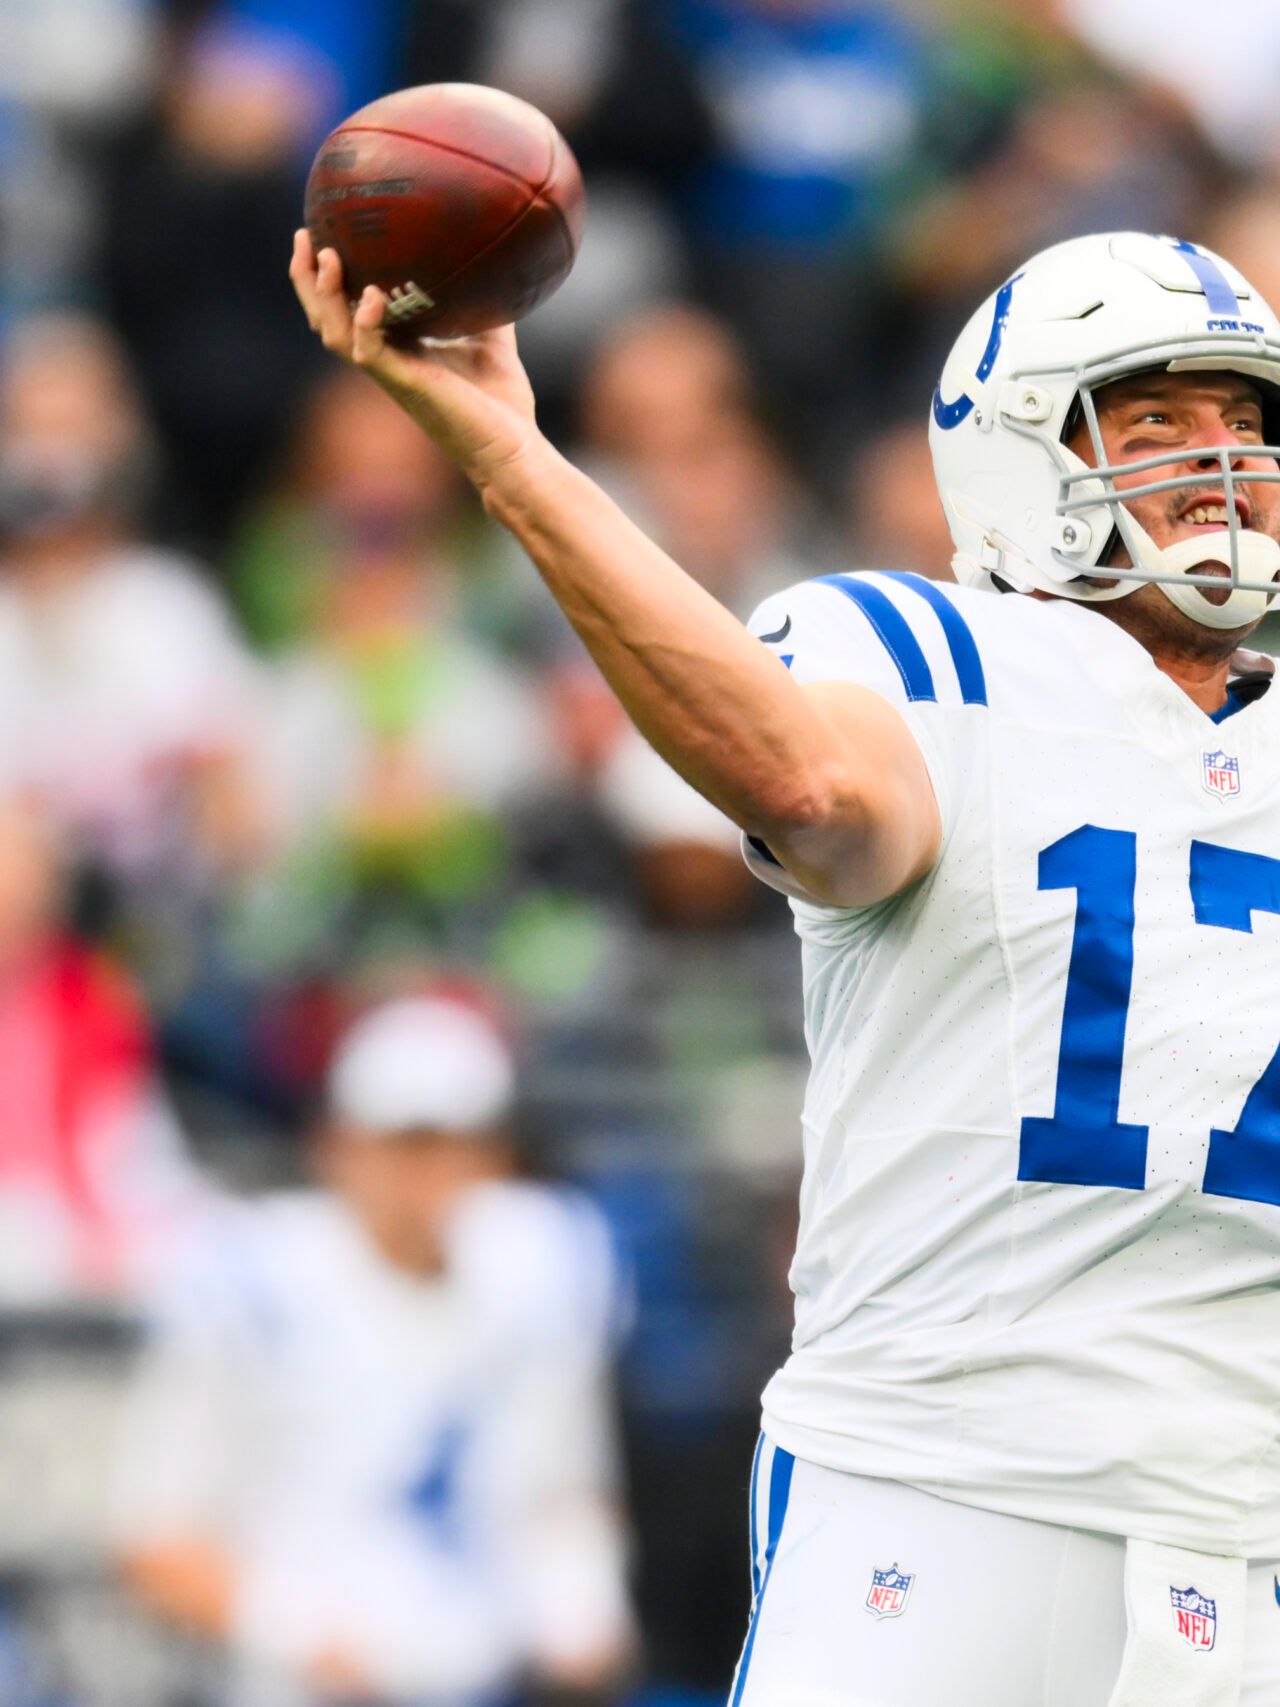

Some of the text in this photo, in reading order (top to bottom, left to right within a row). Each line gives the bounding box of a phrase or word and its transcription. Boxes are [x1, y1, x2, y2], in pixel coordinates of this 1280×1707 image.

[1208, 769, 1237, 790] NFL
[870, 1587, 899, 1610] NFL
[1177, 1609, 1210, 1646] NFL
